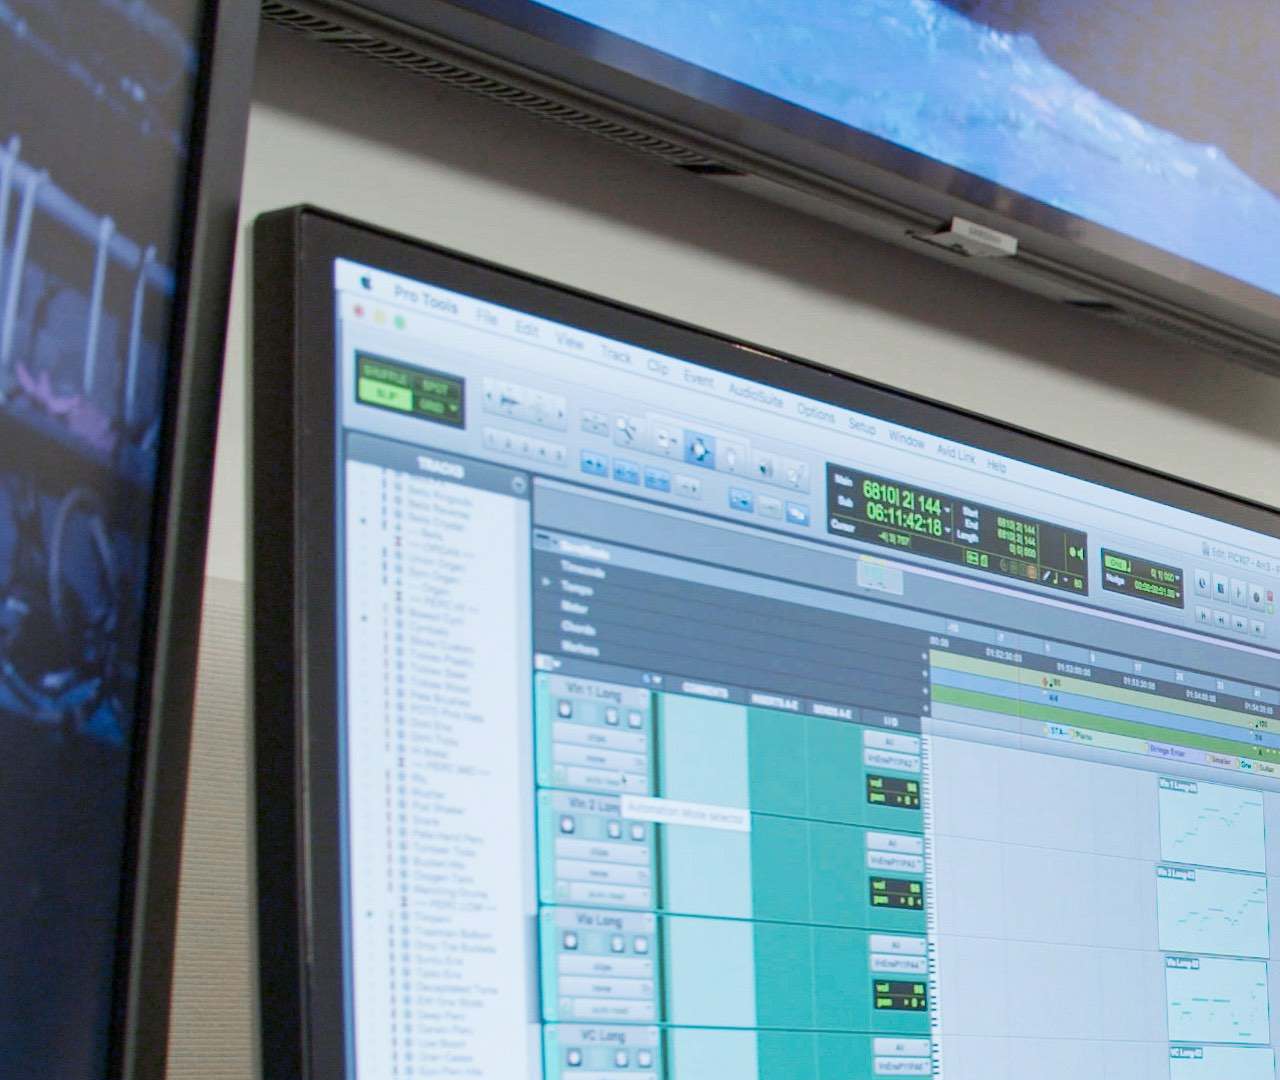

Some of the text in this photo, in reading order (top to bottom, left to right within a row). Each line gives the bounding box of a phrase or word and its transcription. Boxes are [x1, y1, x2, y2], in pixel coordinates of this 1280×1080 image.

[395, 285, 458, 314] Pro Tools
[475, 308, 498, 325] File
[515, 320, 539, 338] Edit
[556, 332, 584, 350] View
[601, 344, 632, 364] Track
[648, 358, 669, 377] Clip
[684, 369, 715, 388] Event
[729, 382, 785, 408] AudioSuite
[798, 402, 835, 424] Options
[849, 417, 877, 436] Setup
[888, 429, 925, 450] Window
[937, 442, 977, 465] Avid Link
[987, 459, 1008, 475] Help
[918, 495, 941, 516] 144
[866, 501, 942, 536] 06:11:42:18
[596, 687, 622, 703] Long
[577, 913, 623, 929] Vla Long
[581, 1029, 626, 1044] VC Long
